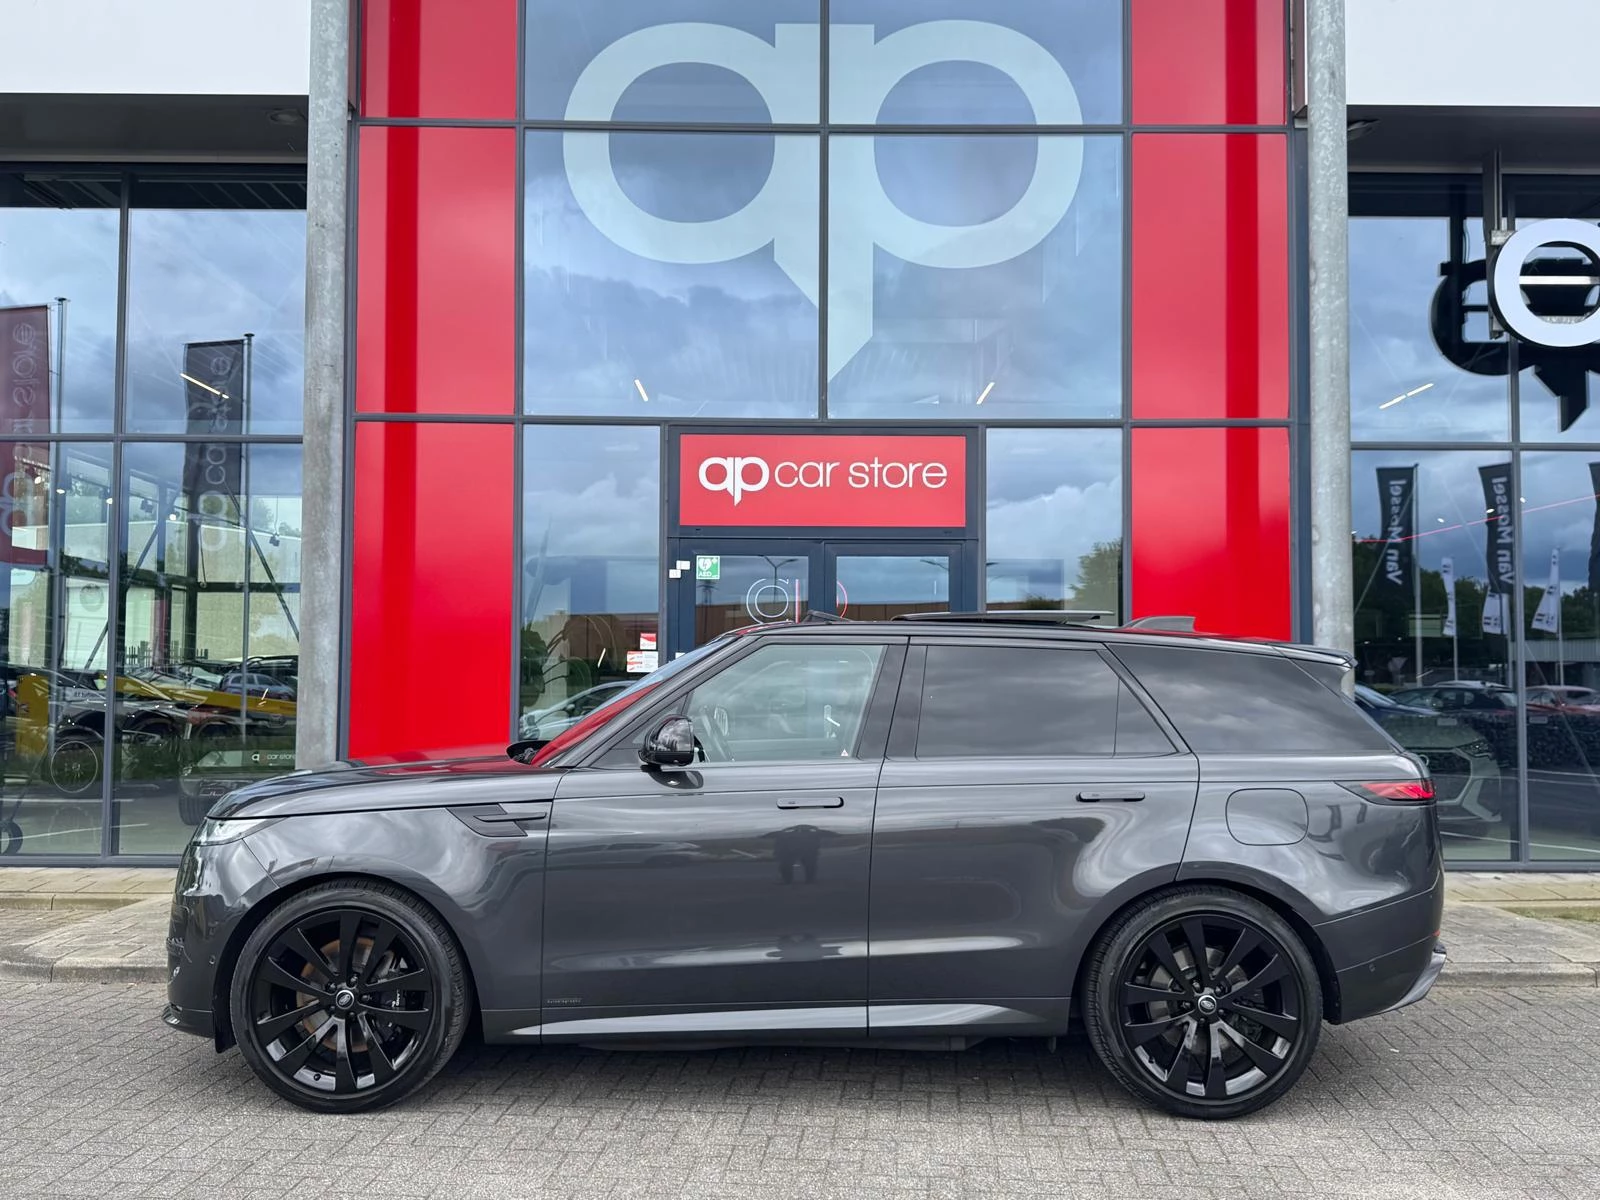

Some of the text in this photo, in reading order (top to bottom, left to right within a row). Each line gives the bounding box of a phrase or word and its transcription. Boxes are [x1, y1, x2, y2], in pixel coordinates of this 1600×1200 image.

[563, 20, 1083, 382] ap
[699, 457, 948, 506] ap car store
